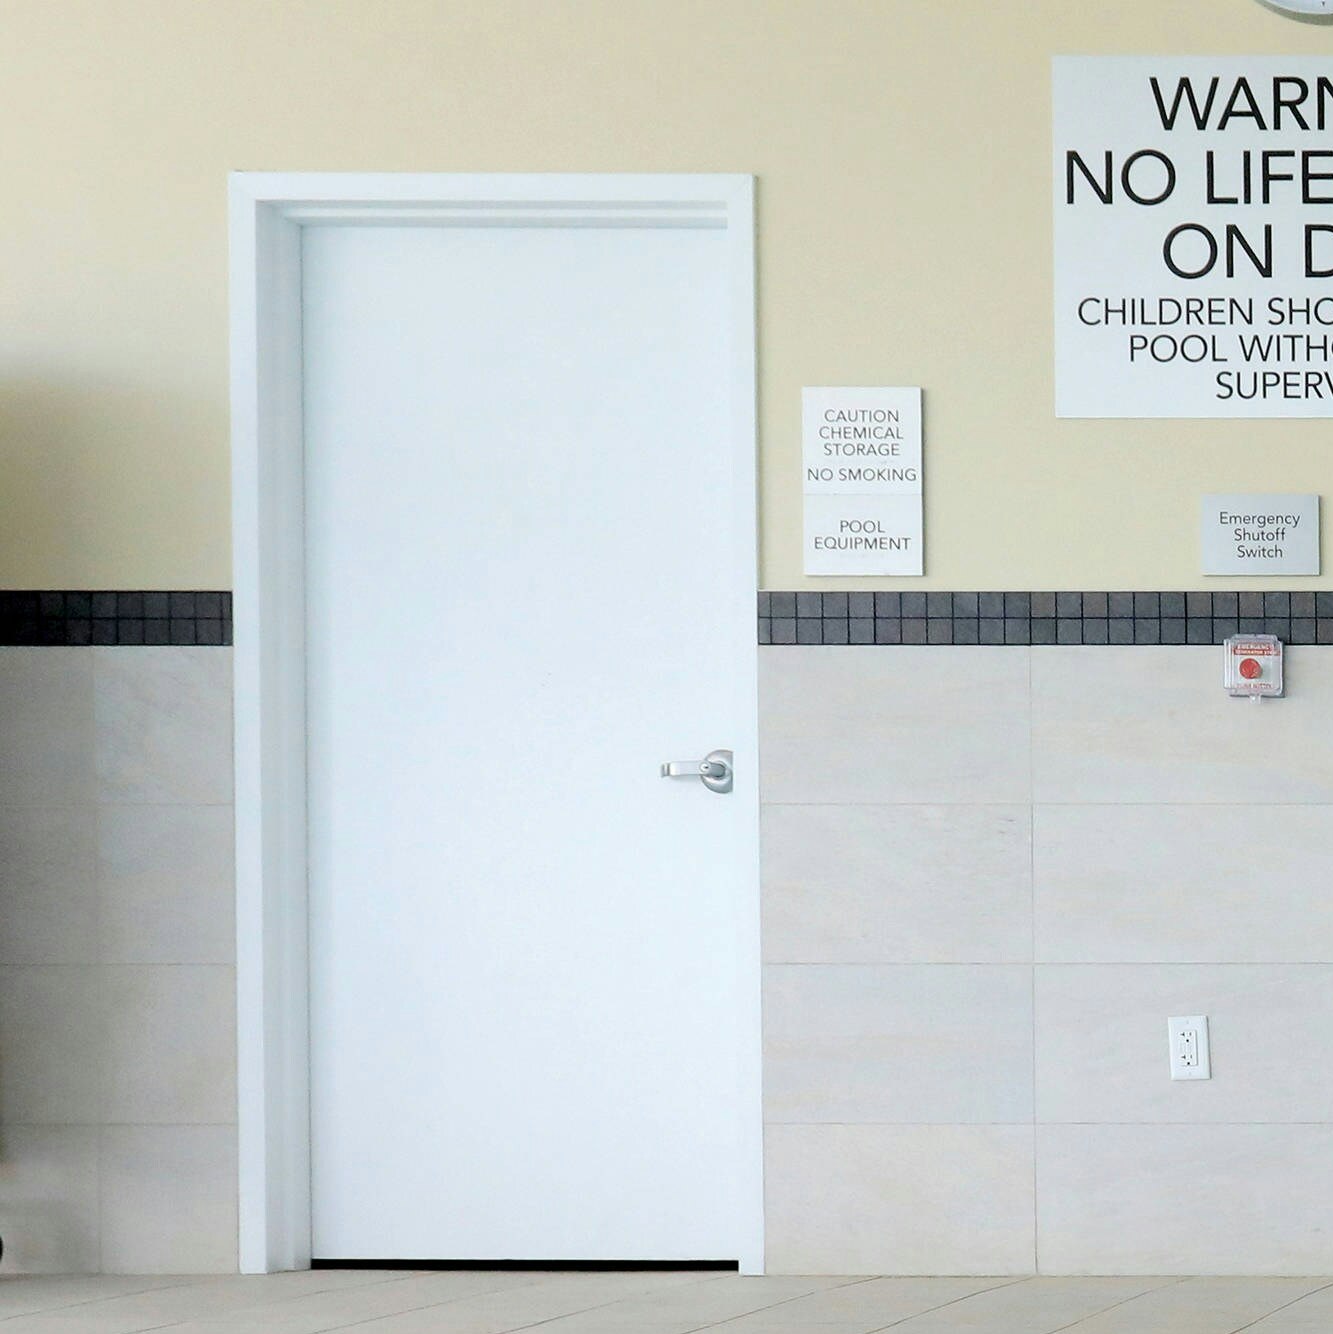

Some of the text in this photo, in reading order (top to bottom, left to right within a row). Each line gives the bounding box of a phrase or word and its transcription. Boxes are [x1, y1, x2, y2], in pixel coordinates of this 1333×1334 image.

[1066, 149, 1176, 206] NO
[1163, 223, 1272, 280] ON
[1078, 297, 1253, 326] CHILDREN
[1130, 334, 1228, 363] POOL
[824, 409, 899, 423] CAUTION
[819, 426, 904, 440] CHEMICAL
[824, 442, 900, 456] STORAGE
[808, 468, 916, 482] NO SMOKING
[840, 520, 886, 534] POOL
[1220, 511, 1300, 529] Emergency
[1234, 528, 1286, 541] Shutoff
[814, 536, 911, 550] EQUIPMENT
[1237, 544, 1283, 558] Switch
